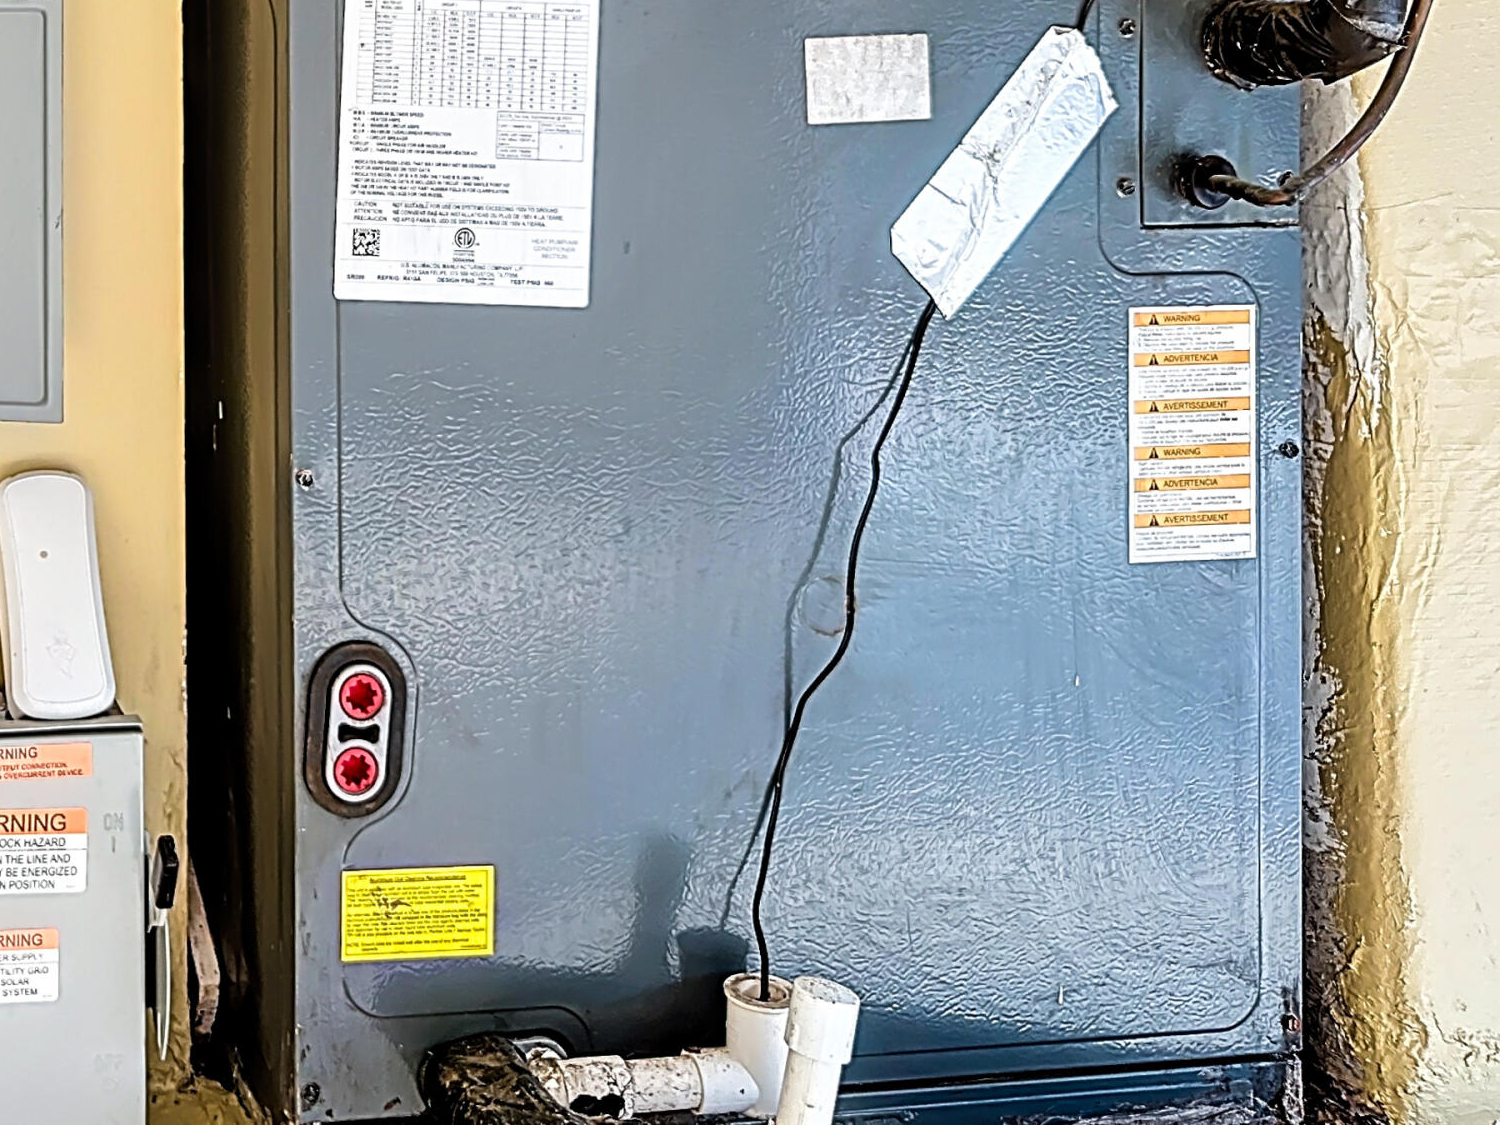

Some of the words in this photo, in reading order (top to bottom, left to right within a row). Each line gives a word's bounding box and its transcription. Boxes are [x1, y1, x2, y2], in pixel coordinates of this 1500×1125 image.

[1164, 314, 1201, 323] WARNING
[1163, 354, 1219, 362] ADVERTENCIA
[1163, 401, 1228, 410] AVERTISSEMENT
[1163, 447, 1201, 456] WARNING
[1163, 479, 1218, 488] ADVERTENCIA
[1164, 514, 1228, 523] AVERTISSEMENT
[24, 837, 66, 848] HAZARD
[6, 855, 24, 864] THE
[27, 854, 48, 864] LINE
[51, 854, 71, 863] AND
[6, 868, 19, 877] BE
[22, 866, 77, 877] ENERGIZED
[9, 879, 55, 889] POSITION
[0, 978, 29, 986] SOLAR
